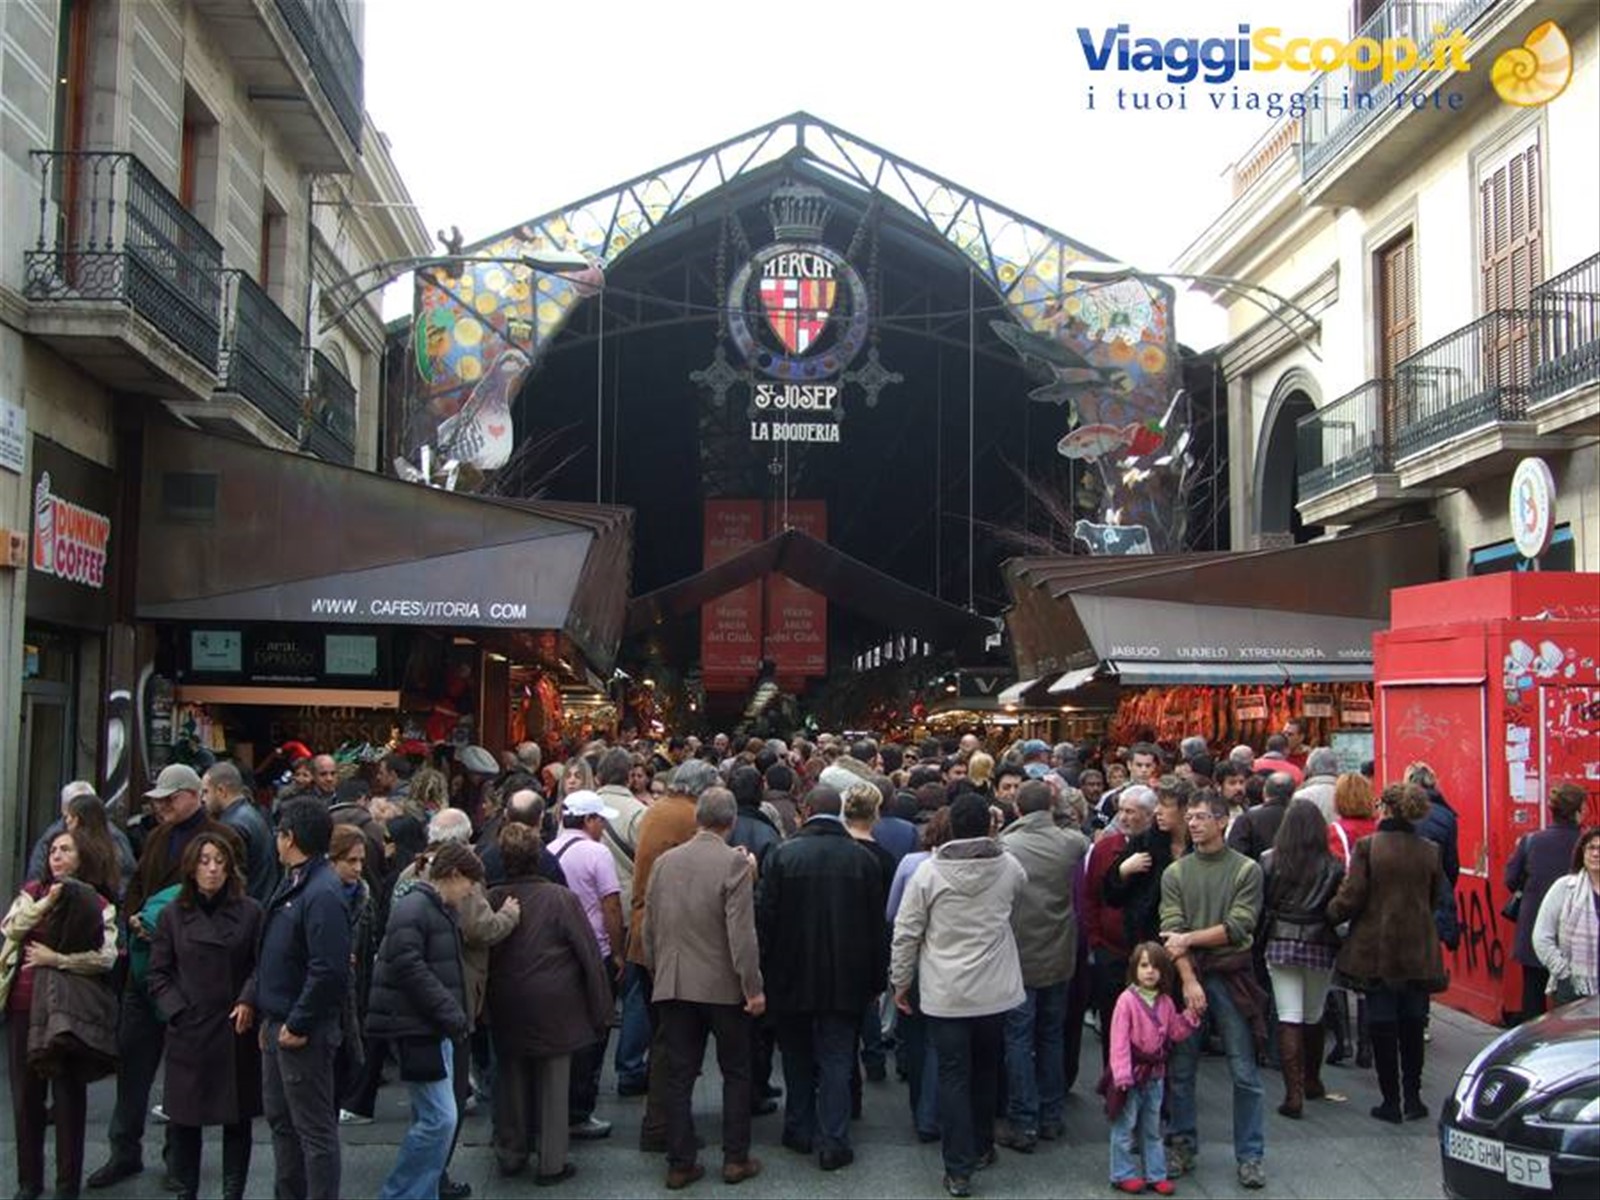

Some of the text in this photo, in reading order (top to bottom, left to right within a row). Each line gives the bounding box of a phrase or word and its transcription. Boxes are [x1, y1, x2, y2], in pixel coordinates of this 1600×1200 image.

[763, 252, 836, 278] MERCAT
[774, 384, 838, 410] JOSEP
[751, 421, 840, 443] LA BOQUERIA
[55, 538, 105, 587] COFFEE
[1510, 1156, 1542, 1182] SP
